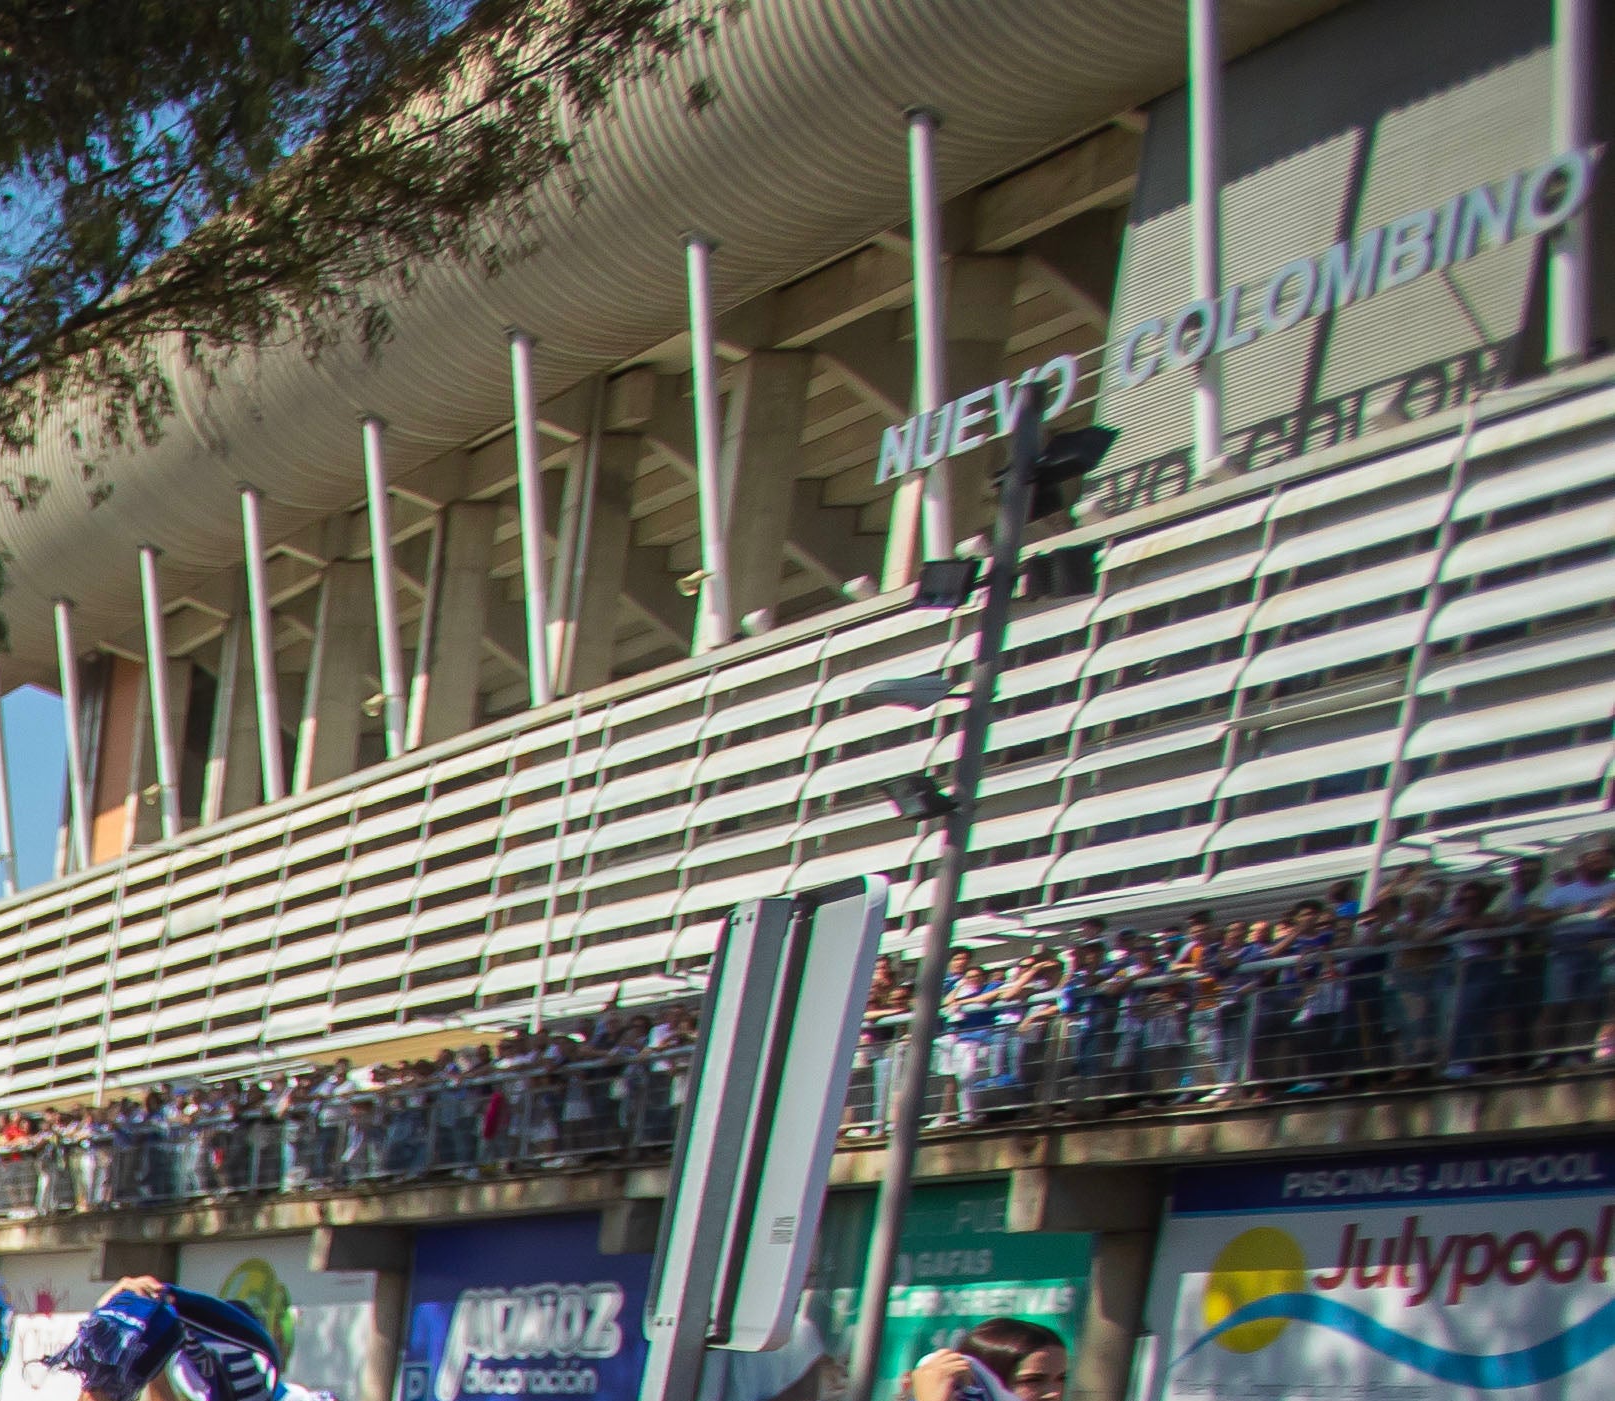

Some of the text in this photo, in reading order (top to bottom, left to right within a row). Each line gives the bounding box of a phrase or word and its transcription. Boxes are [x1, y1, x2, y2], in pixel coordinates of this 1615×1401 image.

[876, 354, 1078, 484] NUEVO
[1119, 149, 1593, 388] COLOMBINO
[1282, 1152, 1603, 1199] PISCINAS JULYPOOL
[1313, 1205, 1615, 1307] Julypool
